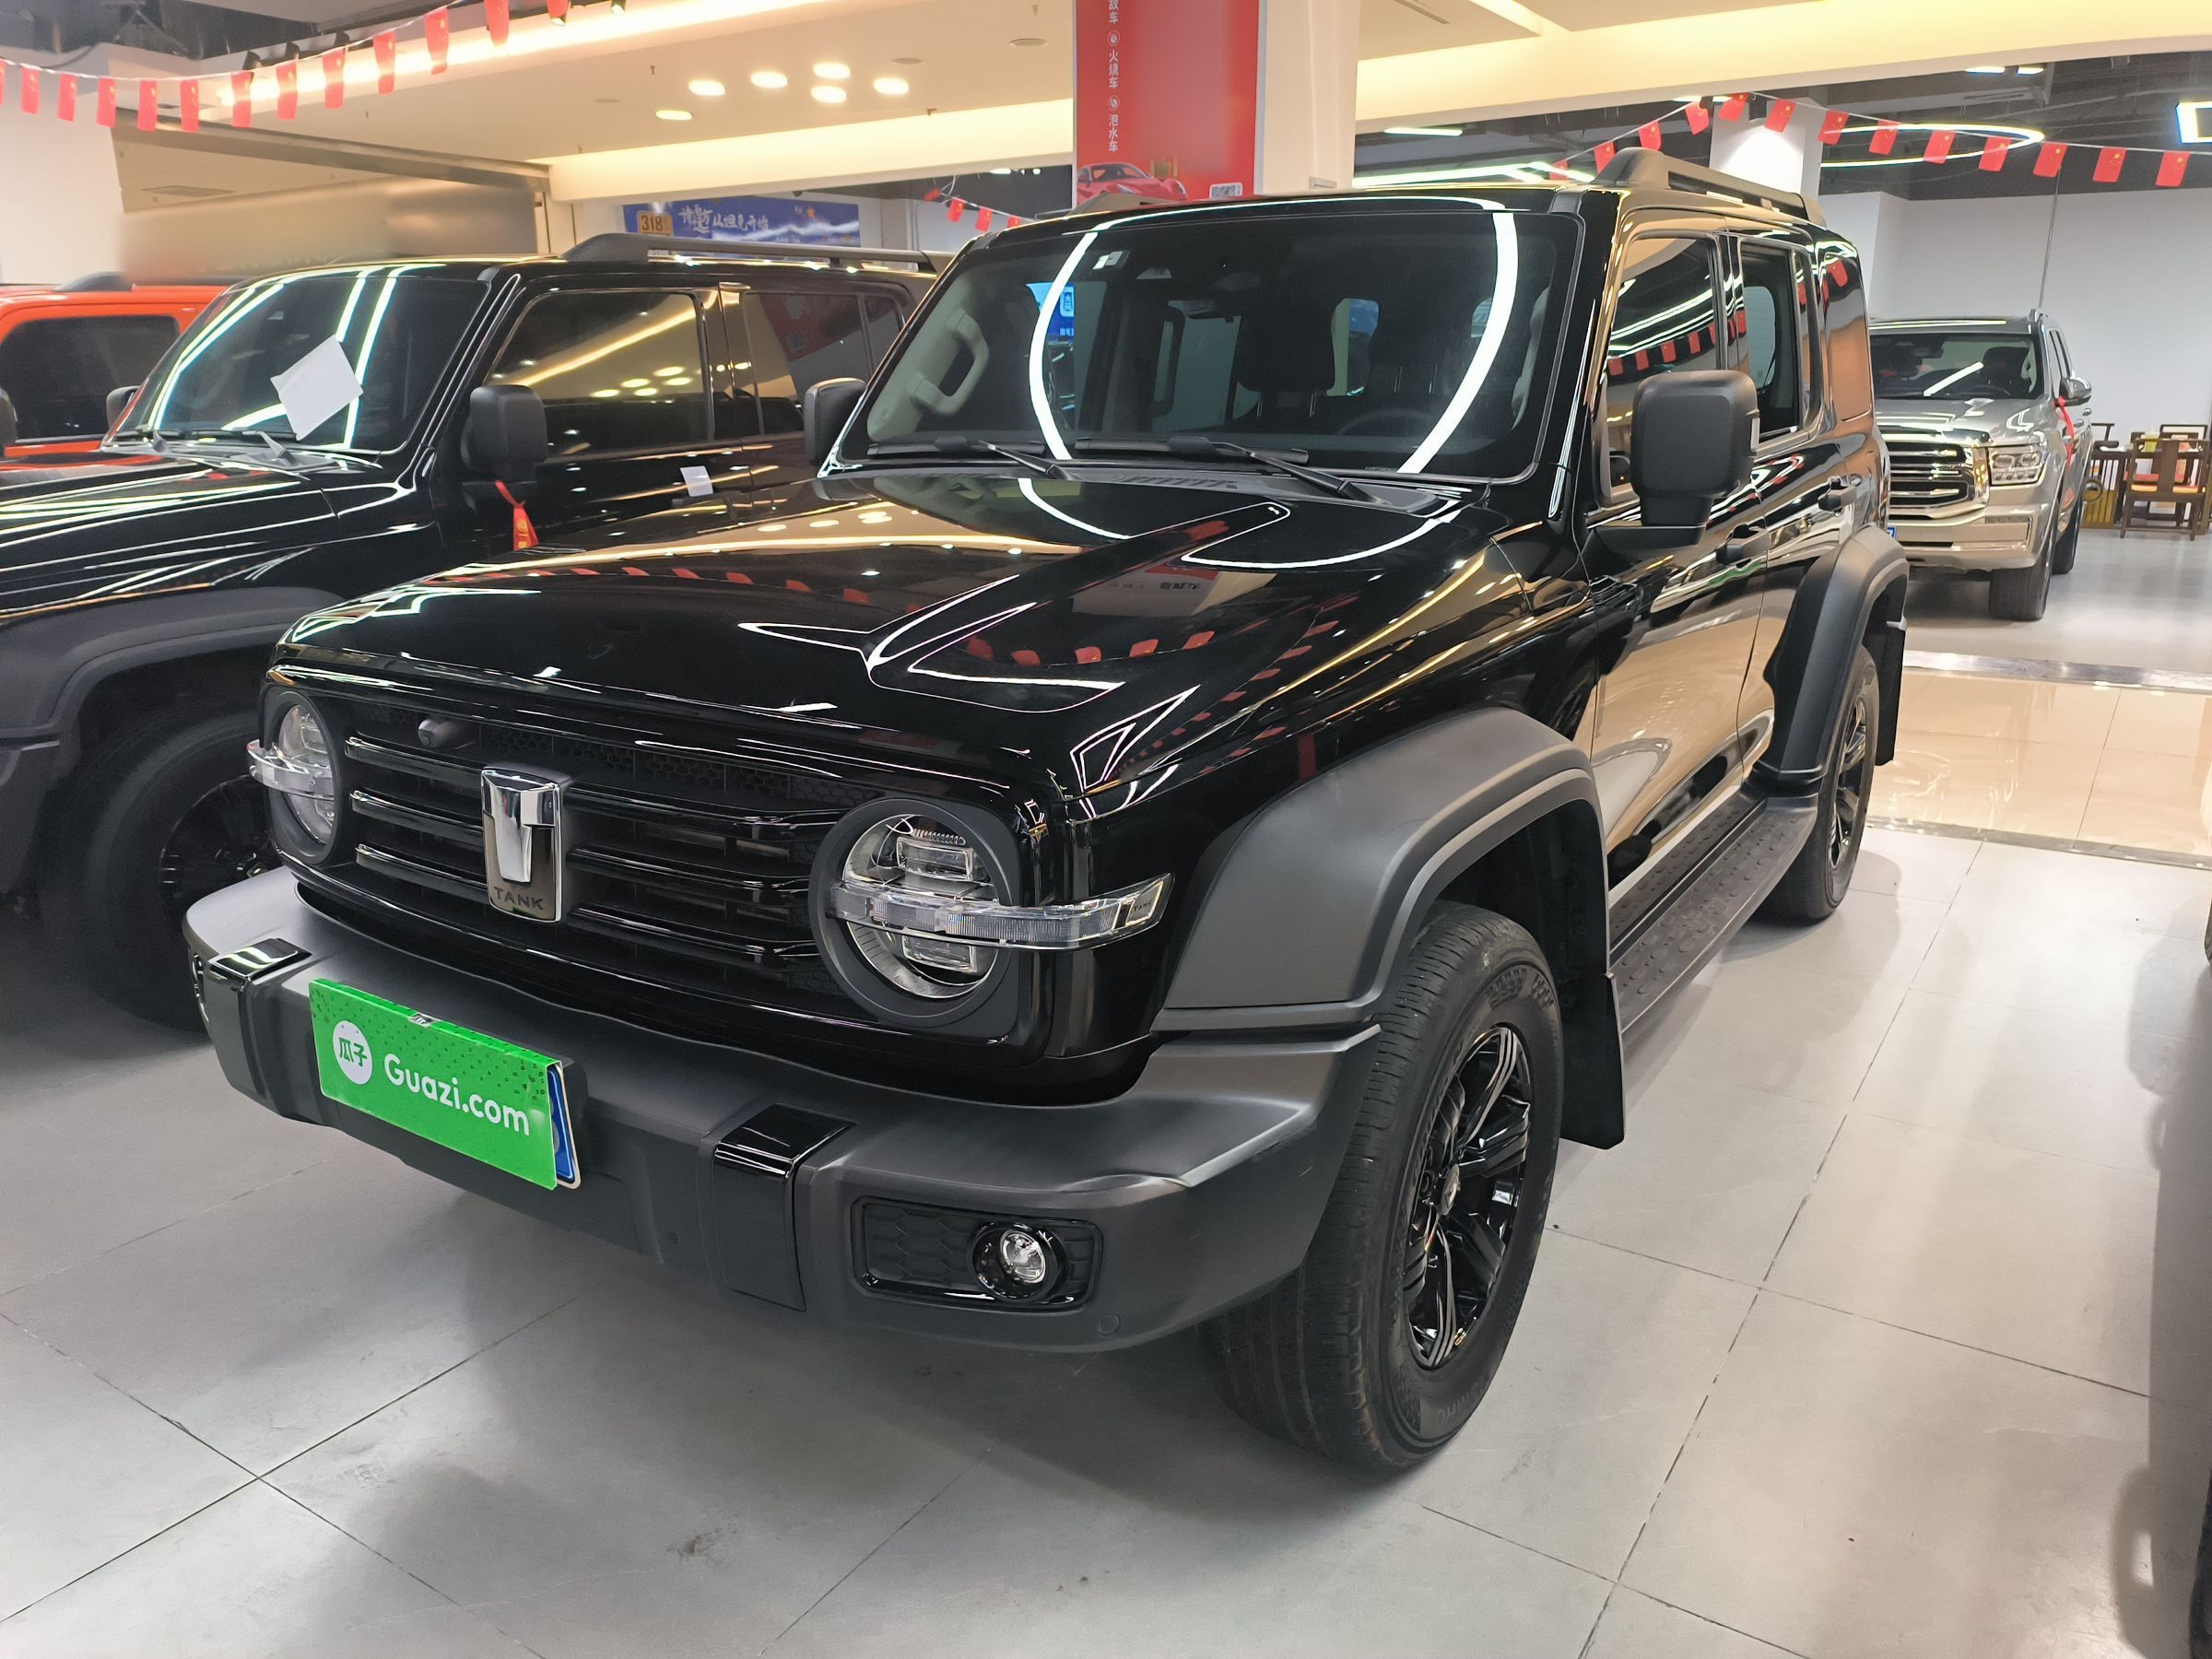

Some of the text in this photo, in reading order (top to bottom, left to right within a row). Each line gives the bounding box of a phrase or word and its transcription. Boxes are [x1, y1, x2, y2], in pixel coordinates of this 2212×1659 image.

[1109, 49, 1119, 89] 火烧车
[640, 215, 664, 231] 318
[493, 886, 545, 911] TANK
[1134, 900, 1152, 912] TANK
[337, 1035, 368, 1068] 瓜子
[382, 1053, 531, 1137] Guazi.com
